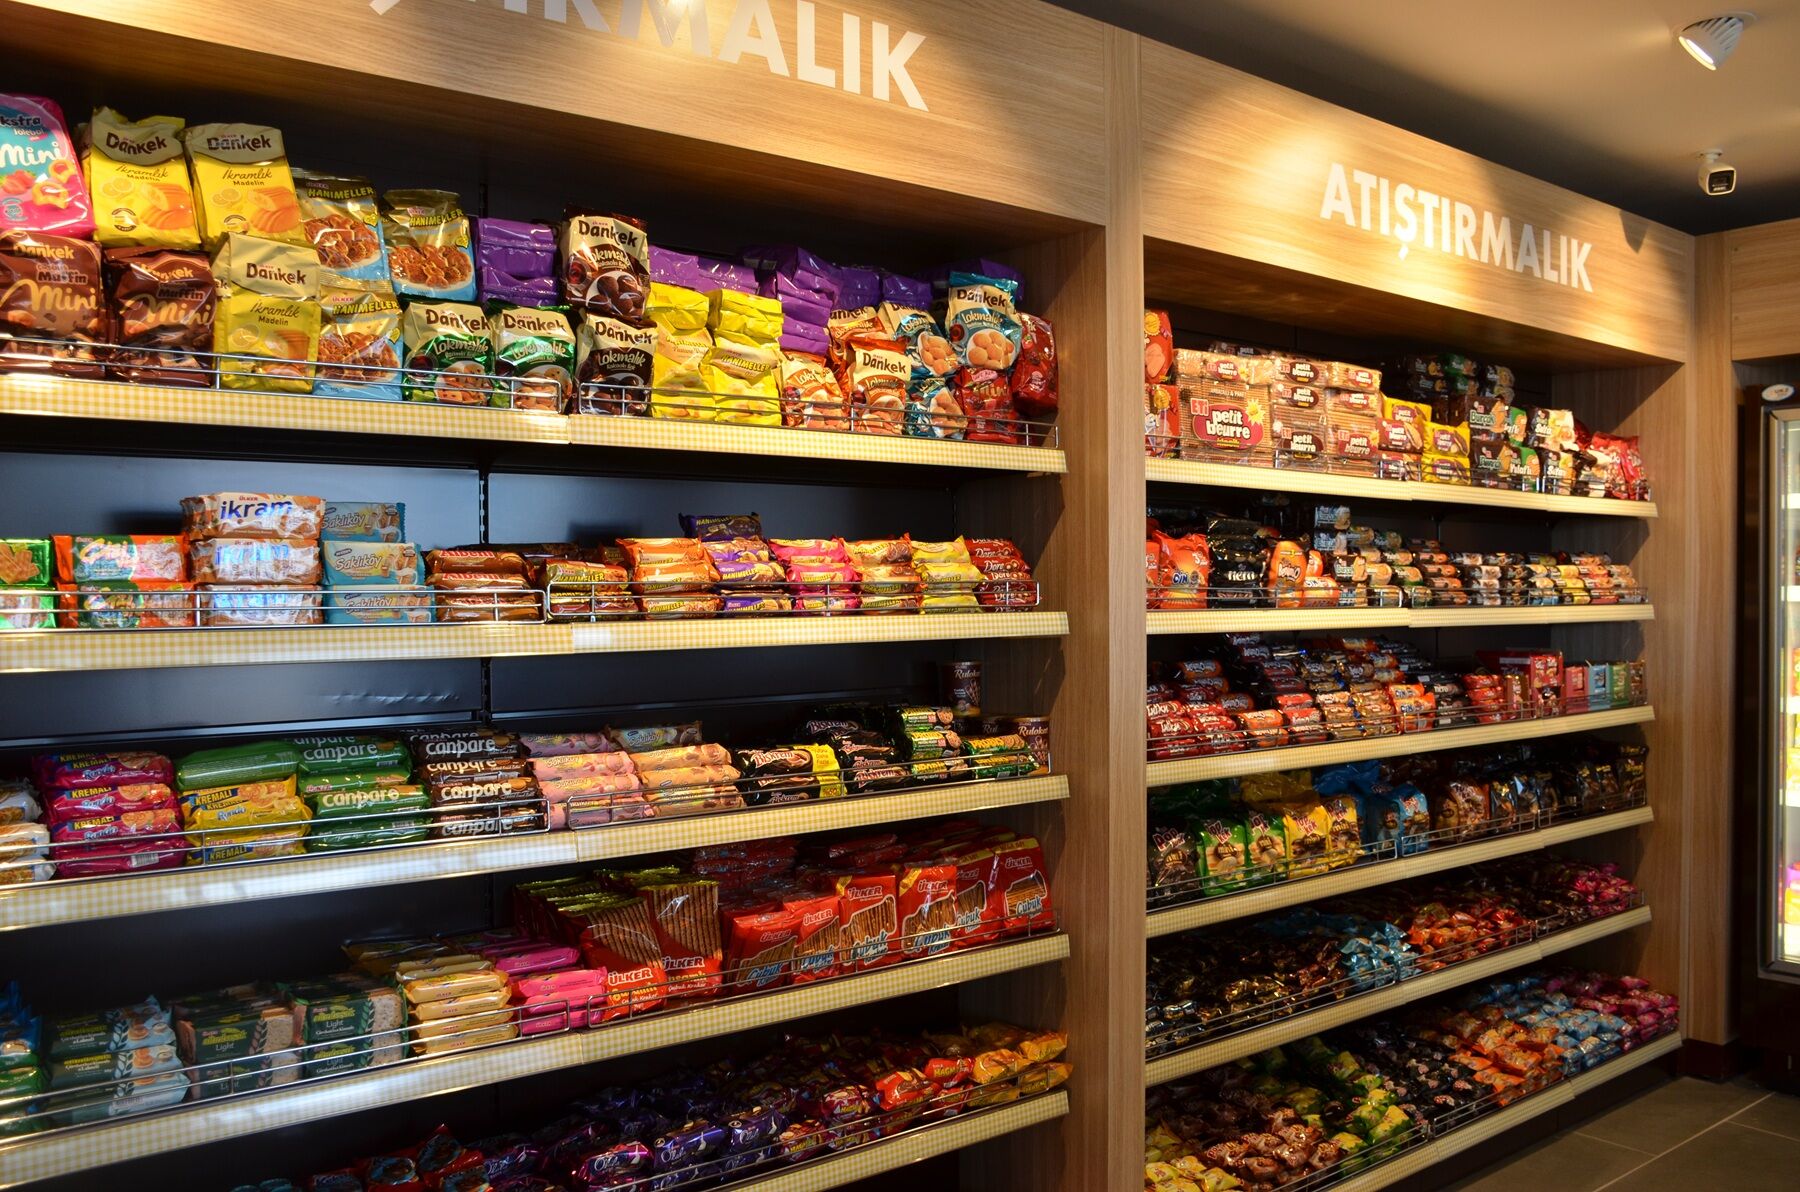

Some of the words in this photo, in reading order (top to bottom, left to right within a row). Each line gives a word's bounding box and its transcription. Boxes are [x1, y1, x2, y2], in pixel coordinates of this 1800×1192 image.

[0, 116, 41, 127] kstra
[106, 132, 168, 156] Dankek
[207, 135, 272, 152] Dankek
[0, 141, 62, 168] Mini
[308, 186, 374, 200] HANIMELLER
[578, 220, 638, 248] Dankek
[1319, 162, 1594, 294] ATIŞTIRMALIK
[14, 244, 75, 260] Dankek
[246, 263, 307, 286] Dankek
[0, 279, 97, 312] Mini
[158, 288, 206, 301] Muffin
[957, 289, 1007, 308] Dankek
[333, 301, 400, 316] HANIMELLER
[258, 315, 289, 326] Madelin
[426, 309, 490, 333] Dankek
[503, 314, 566, 331] Dankek
[595, 320, 653, 345] Dankek
[863, 352, 907, 375] Dankek
[1212, 409, 1243, 426] petit
[1205, 420, 1252, 440] beurre
[1292, 434, 1313, 446] petit
[220, 500, 293, 521] ikram
[303, 742, 378, 763] canpare
[425, 737, 496, 759] canpare
[752, 749, 794, 769] Biskrem
[71, 787, 113, 799] KREMALI
[194, 788, 233, 806] KREMALI
[322, 788, 400, 809] canpare
[440, 781, 513, 801] canpare
[73, 816, 116, 831] KREMALI
[208, 847, 248, 864] KREMALI
[849, 886, 883, 899] ÜLKER
[803, 909, 834, 926] ÜLKER
[661, 956, 706, 971] ÜLKER
[608, 967, 654, 986] ÜLKER
[326, 1019, 345, 1030] Light
[215, 1042, 236, 1053] Light
